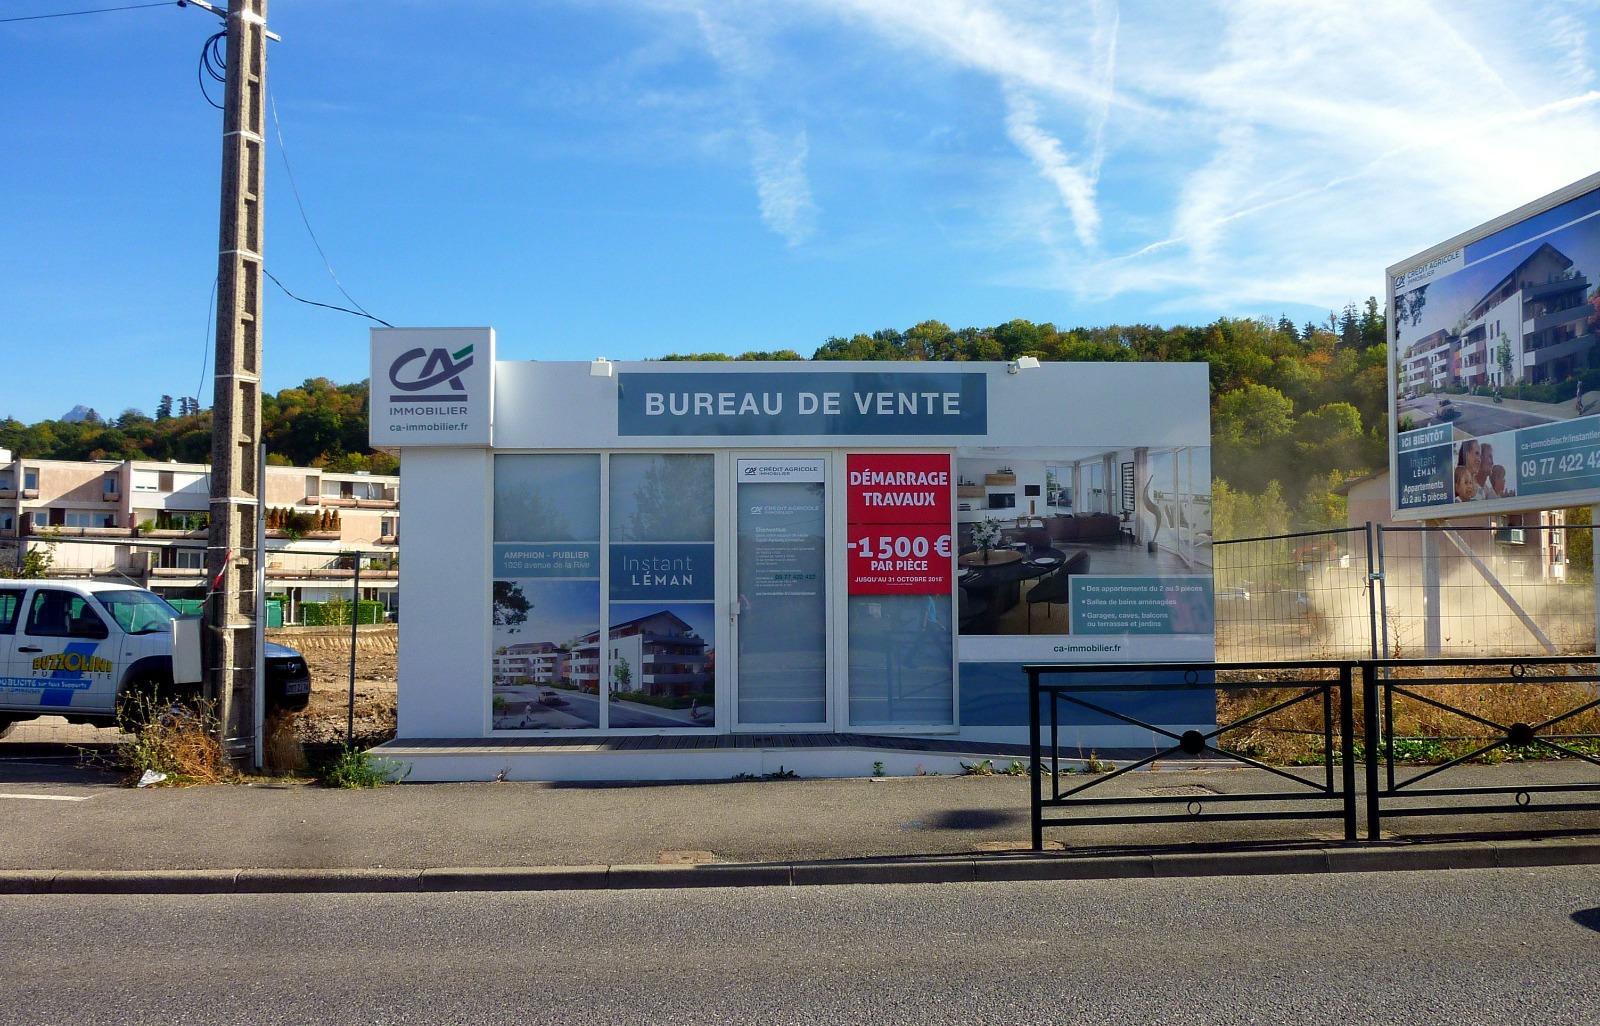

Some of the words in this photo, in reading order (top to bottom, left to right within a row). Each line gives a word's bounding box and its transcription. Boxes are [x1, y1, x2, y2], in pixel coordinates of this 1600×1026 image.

[1430, 251, 1460, 268] AGRICOLE
[390, 407, 468, 415] IMMOBILIER
[645, 392, 783, 416] BUREAU
[798, 392, 841, 415] DE
[854, 392, 960, 415] VENTE
[390, 423, 468, 431] ca-immobilier.fr
[1402, 438, 1411, 447] ICI
[1413, 430, 1444, 446] BIENTÔT
[1413, 466, 1436, 478] LÉMAN
[1522, 460, 1536, 477] 09
[1540, 457, 1555, 475] 77
[1559, 453, 1584, 472] 422
[850, 468, 947, 485] DÉMARRAGE
[1404, 481, 1444, 494] Appartements
[863, 492, 935, 506] TRAVAUX
[1402, 496, 1408, 504] du
[1428, 492, 1447, 503] pièces
[623, 555, 693, 571] Instant
[871, 561, 893, 571] PAR
[896, 559, 928, 571] PIÈCE
[632, 571, 693, 586] LÉMAN
